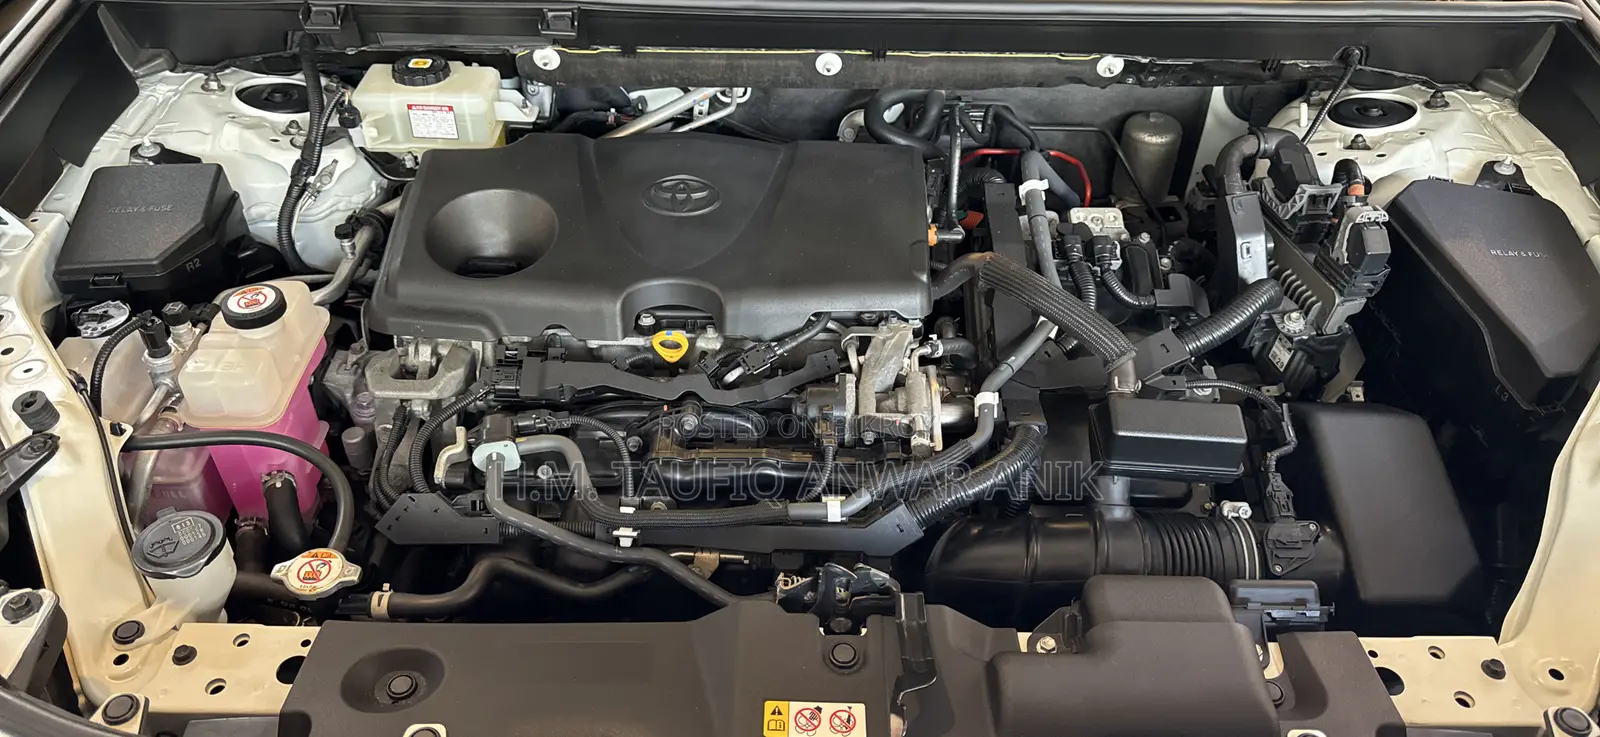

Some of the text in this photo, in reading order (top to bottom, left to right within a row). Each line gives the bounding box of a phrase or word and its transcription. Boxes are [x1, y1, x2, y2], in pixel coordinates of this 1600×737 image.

[149, 204, 174, 212] FUSE
[1489, 249, 1518, 257] RELAY
[185, 258, 202, 273] R2
